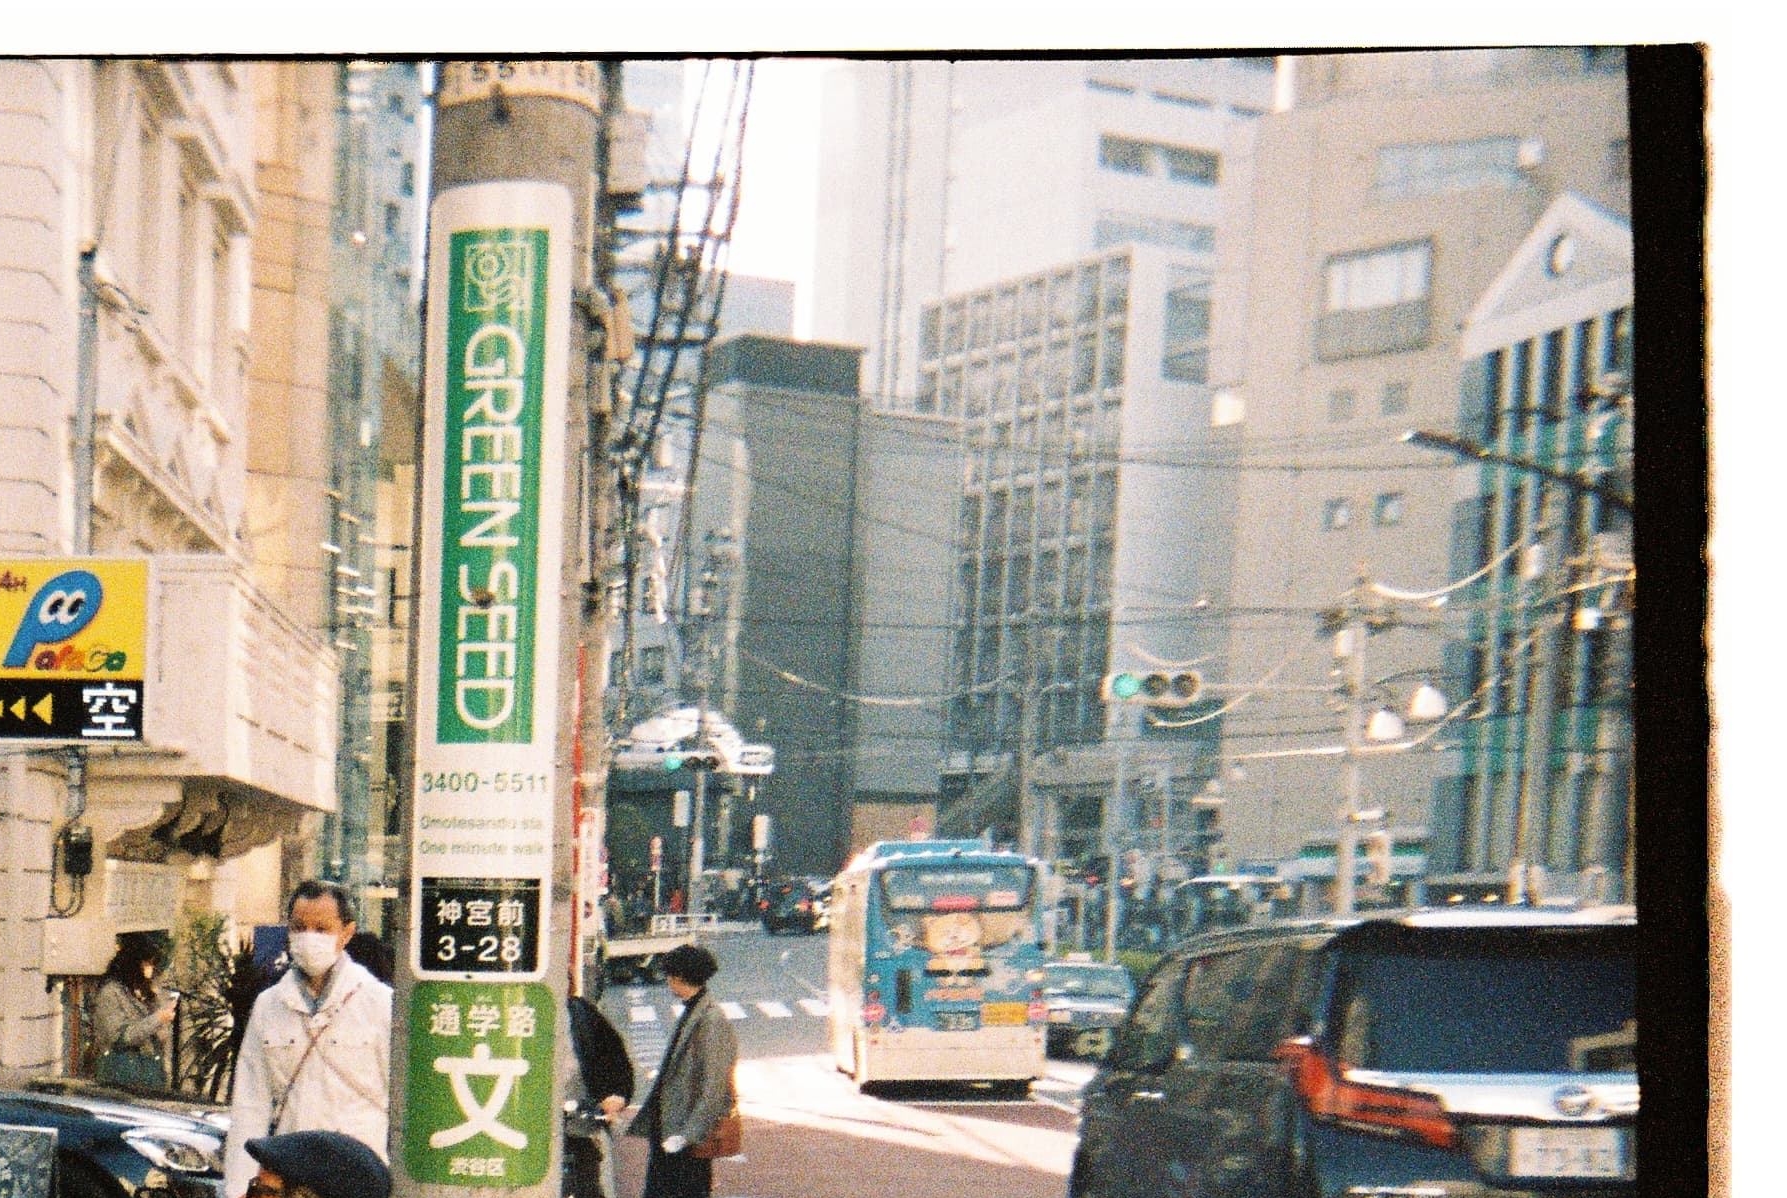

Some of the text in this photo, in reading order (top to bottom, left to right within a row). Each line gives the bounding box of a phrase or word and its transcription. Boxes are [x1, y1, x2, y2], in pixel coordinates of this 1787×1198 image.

[455, 323, 527, 731] GREEN SEED
[80, 682, 138, 738] 空
[435, 898, 526, 927] 神宮前
[436, 934, 522, 963] 3-28
[429, 1002, 537, 1038] 通学路
[428, 1042, 531, 1150] 文
